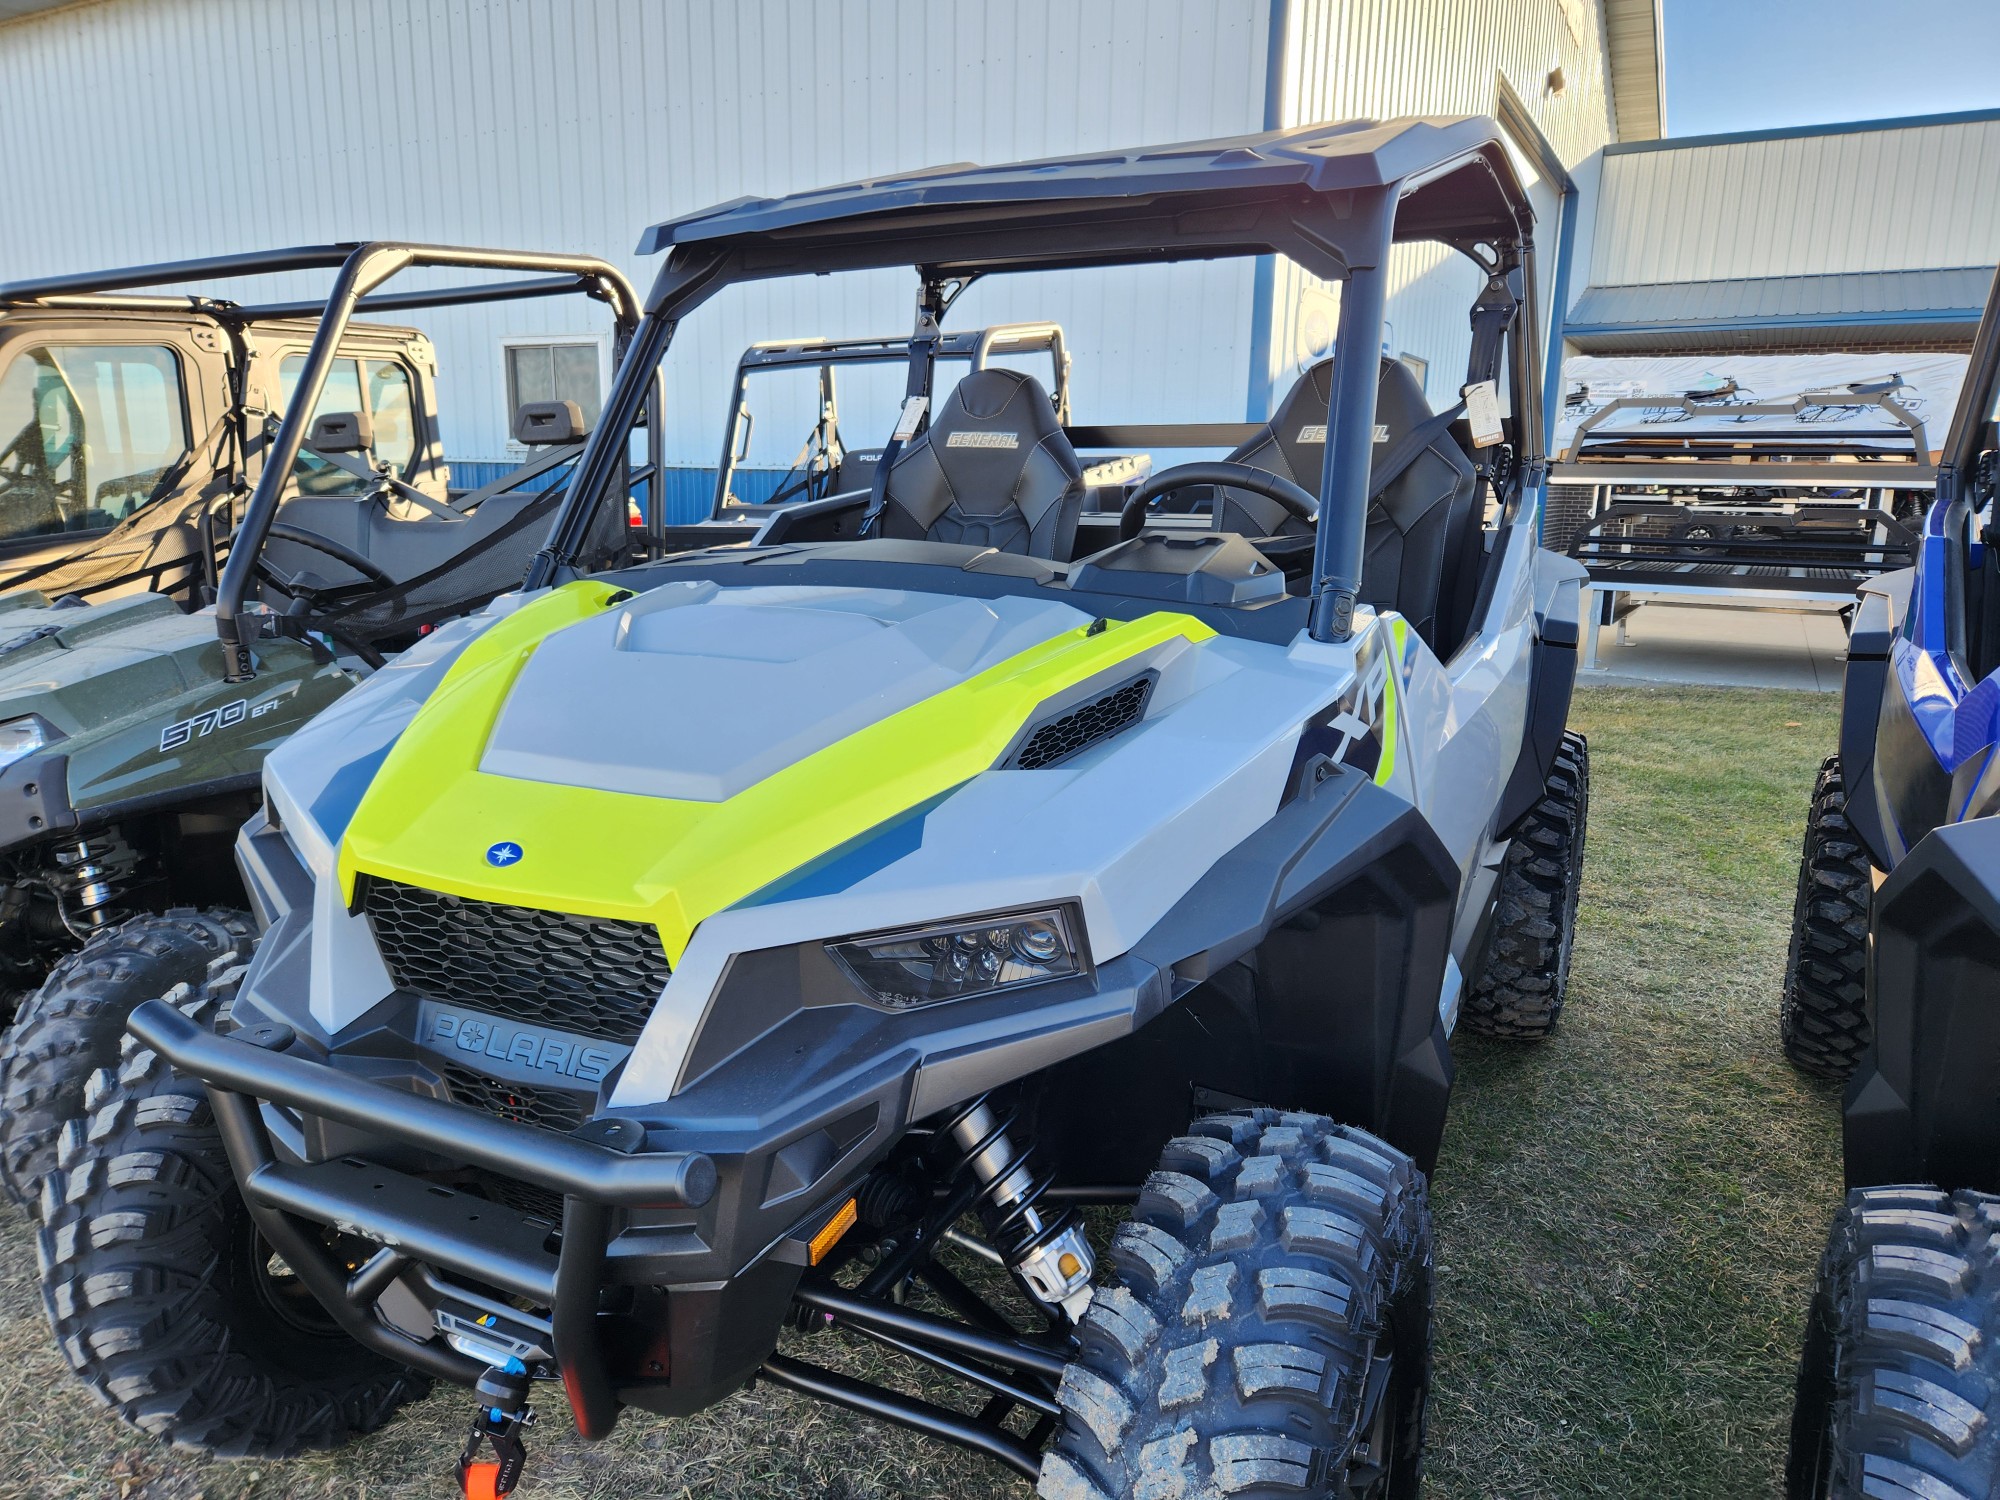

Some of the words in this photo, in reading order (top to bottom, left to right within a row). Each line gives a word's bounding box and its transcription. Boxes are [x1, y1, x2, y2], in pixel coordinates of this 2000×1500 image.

[946, 431, 1019, 449] GENERAL
[160, 699, 247, 752] 570
[251, 700, 278, 718] EFI
[427, 1011, 611, 1083] POLARIS
